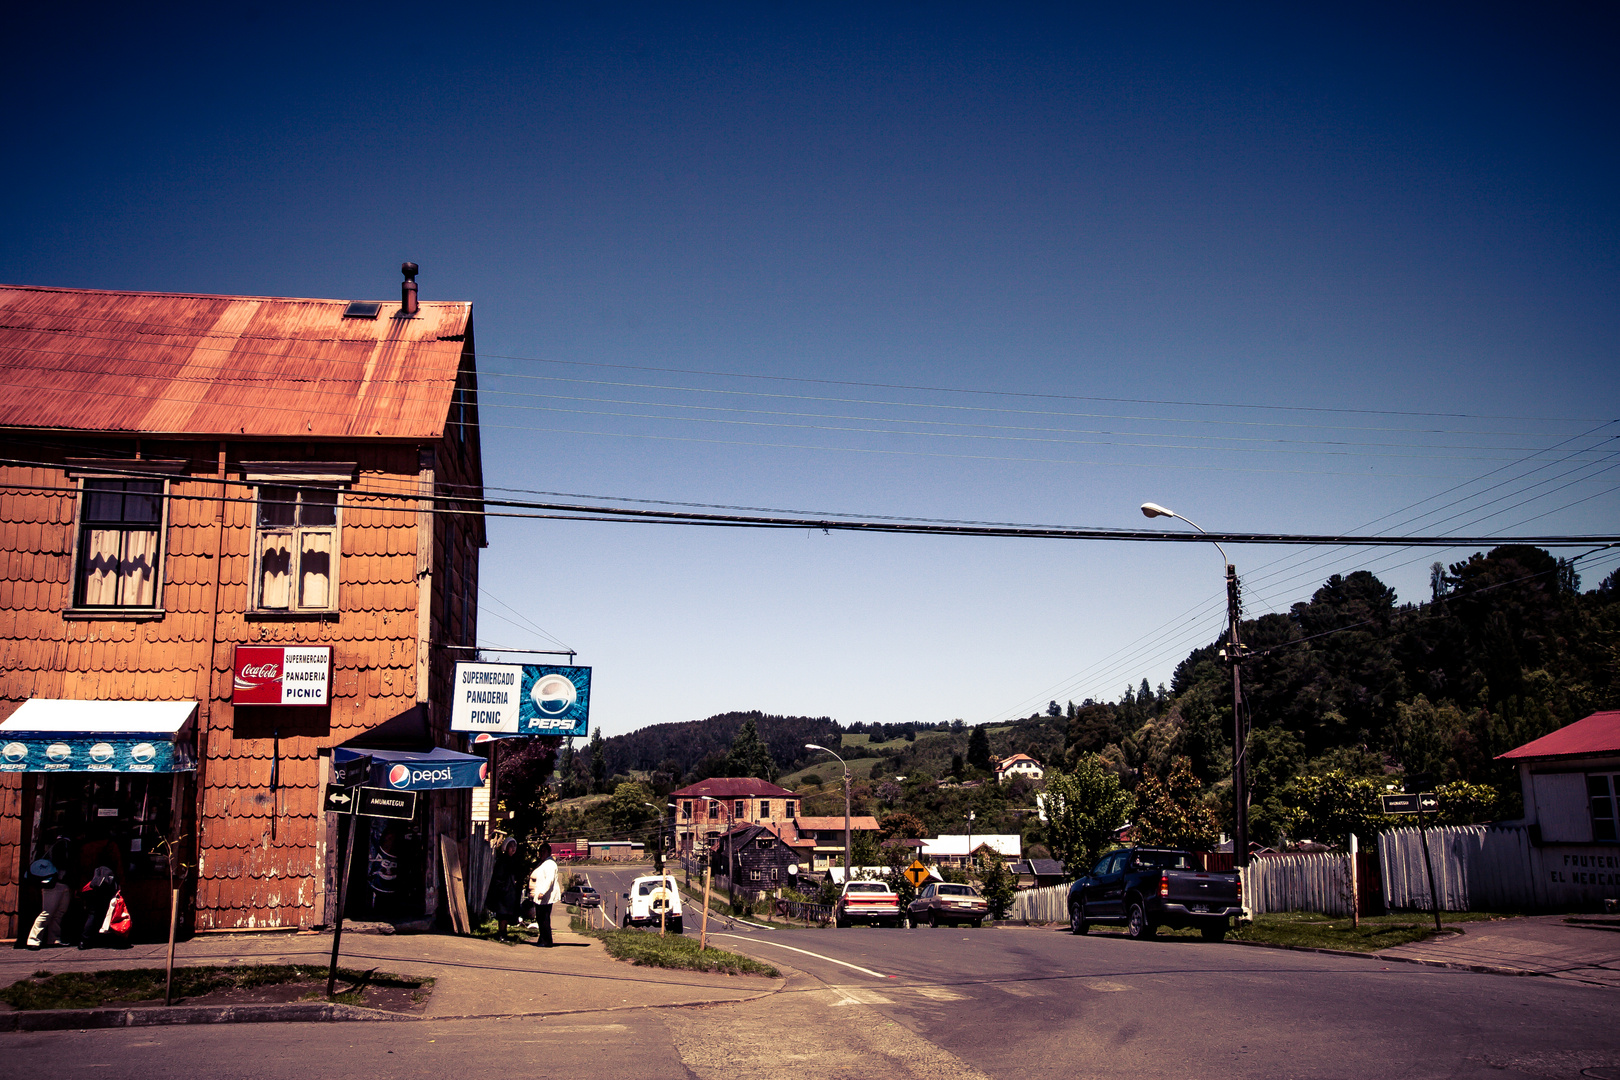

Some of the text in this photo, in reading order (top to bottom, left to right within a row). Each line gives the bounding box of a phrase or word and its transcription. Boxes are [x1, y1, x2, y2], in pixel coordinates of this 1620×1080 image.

[285, 654, 328, 664] SUPERMERCADO
[285, 671, 326, 681] PANADERIA
[462, 671, 515, 686] SUPERMERCADO
[286, 688, 322, 698] PICNIC
[466, 690, 509, 705] PANADERIA
[470, 710, 501, 724] PICNIC
[527, 717, 577, 730] PEPSI
[412, 767, 452, 784] pepsi
[370, 798, 405, 807] AMUNATEGUI
[1551, 871, 1566, 882] EL
